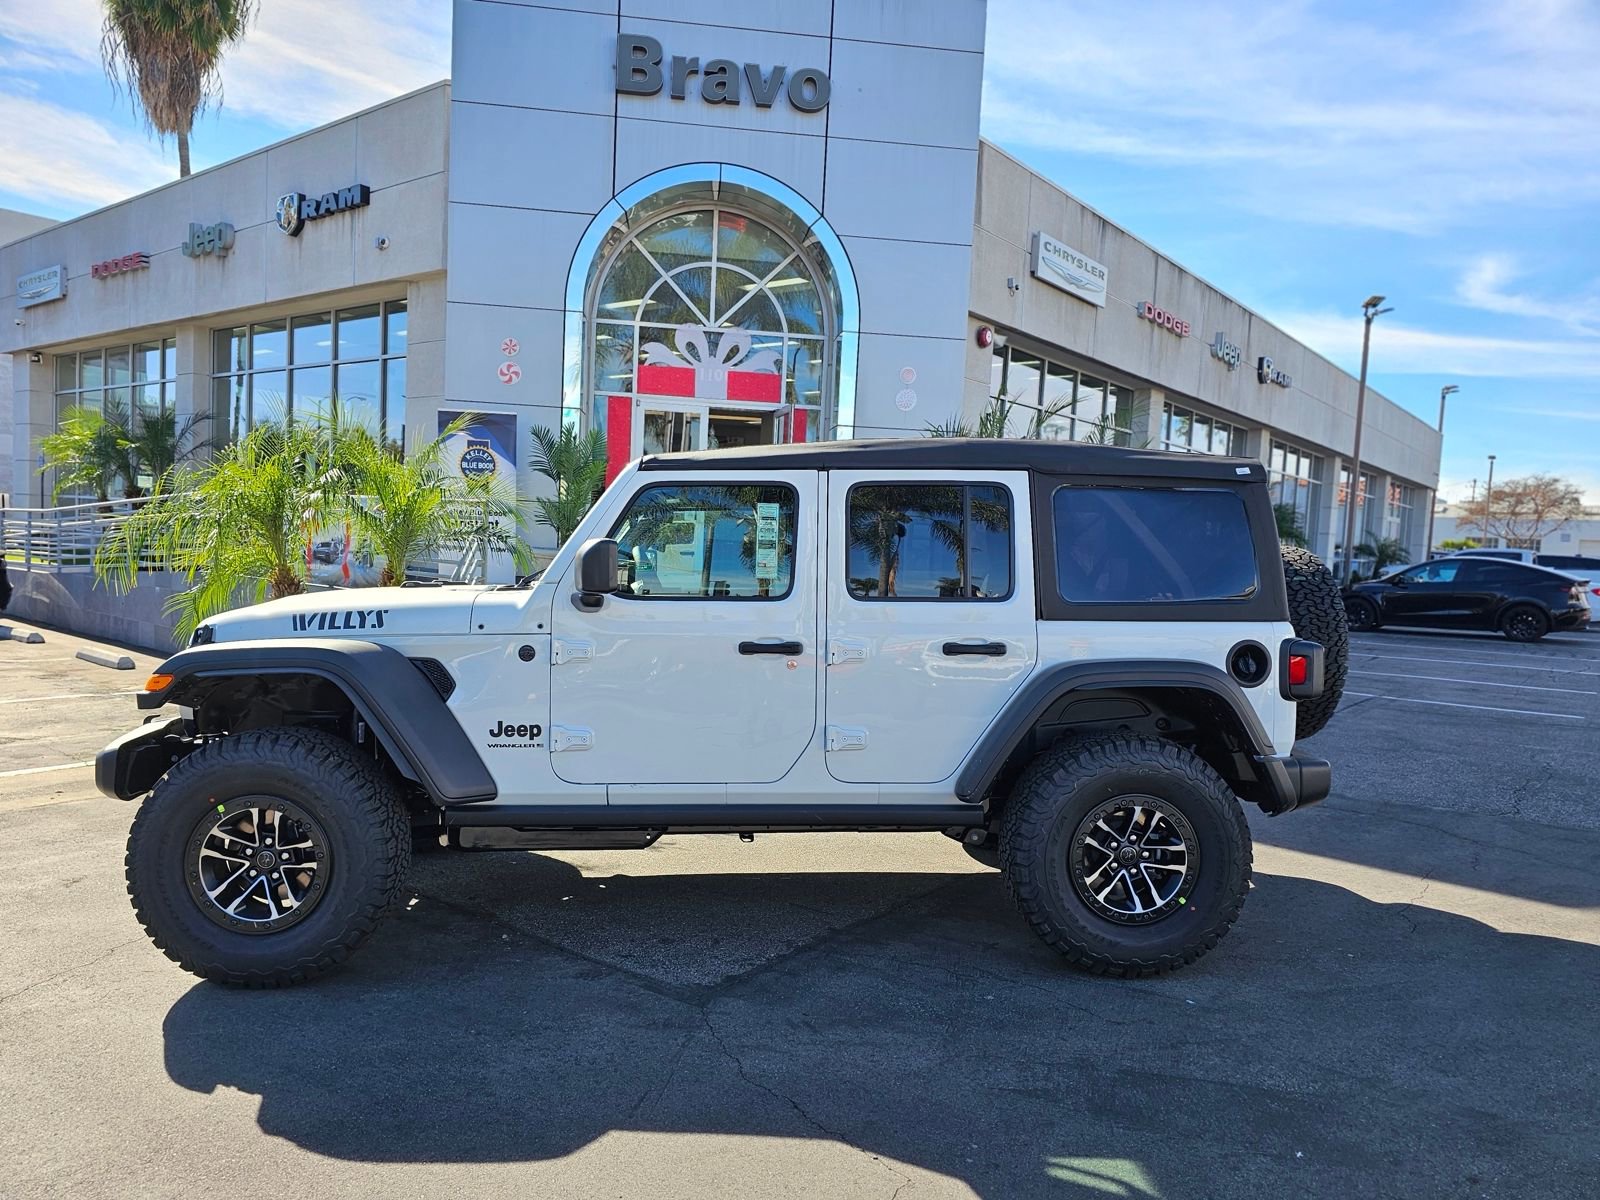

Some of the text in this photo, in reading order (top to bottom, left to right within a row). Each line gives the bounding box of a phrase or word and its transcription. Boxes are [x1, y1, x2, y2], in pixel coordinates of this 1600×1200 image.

[616, 33, 831, 113] Bravo
[301, 184, 370, 221] RAM
[182, 222, 235, 258] Jeep
[92, 252, 150, 280] DODGE
[1044, 241, 1105, 280] CHRYSLER
[18, 270, 58, 289] CHRYSLER
[1141, 302, 1191, 338] DODGE
[1211, 332, 1241, 371] Jeep
[1271, 368, 1292, 388] RAM
[465, 449, 493, 461] KELLEY
[478, 462, 495, 470] BOOK
[292, 609, 389, 631] WILLYS
[489, 720, 542, 741] Jeep
